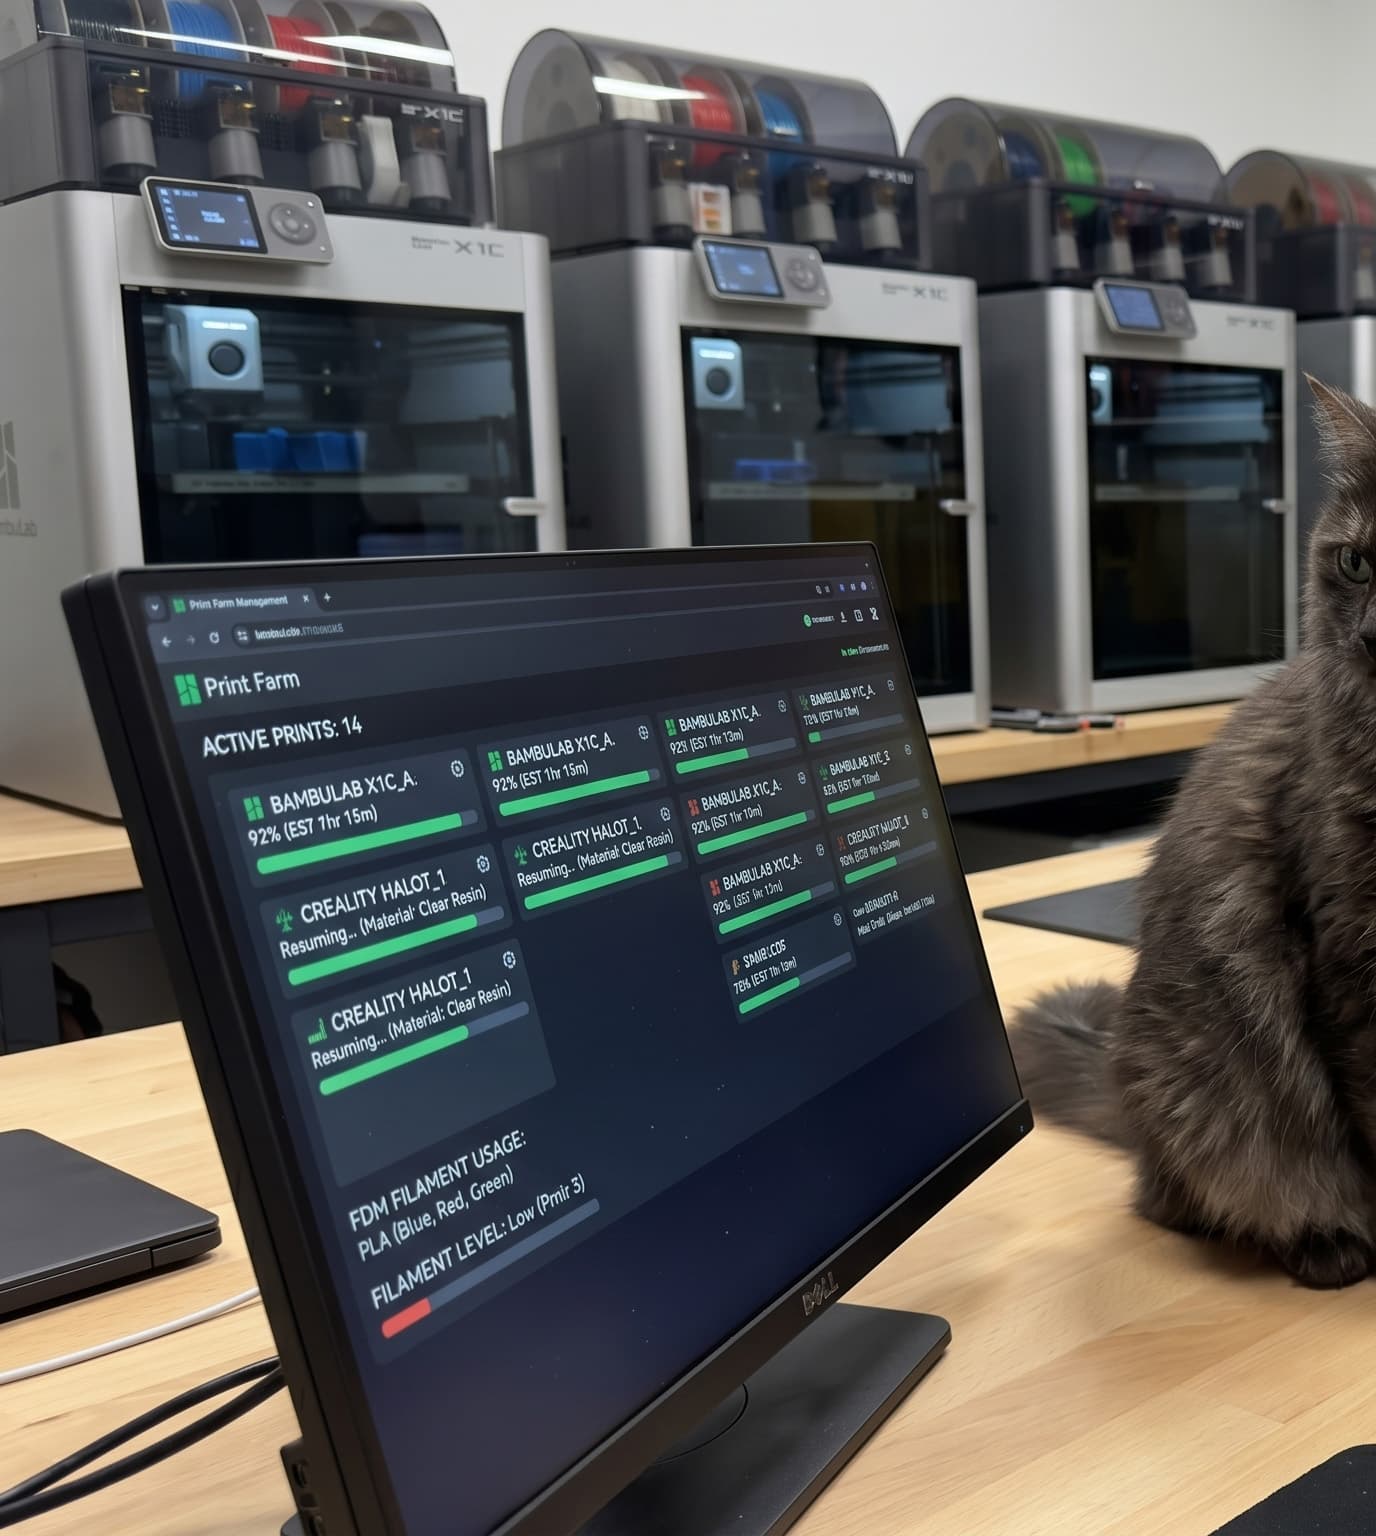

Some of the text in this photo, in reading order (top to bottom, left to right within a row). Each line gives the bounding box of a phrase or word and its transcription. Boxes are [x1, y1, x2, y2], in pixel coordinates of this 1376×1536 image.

[455, 240, 504, 258] X1C
[204, 672, 300, 698] Print Farm
[203, 715, 363, 757] ACTIVE PRINTS: 14
[679, 712, 730, 732] BAMBULAB
[506, 739, 574, 766] BAMBULAB
[492, 760, 589, 793] 92% (EST 1hr 15m)
[270, 780, 363, 814] BAMBULAB
[701, 786, 751, 811] BAMBULAB
[249, 823, 281, 847] 92%
[344, 805, 378, 826] 15m)
[532, 827, 590, 858] CREALITY
[621, 840, 645, 856] Clear
[723, 862, 773, 891] BAMBULAB
[300, 868, 447, 924] CREALITY HALOT_1
[419, 897, 449, 917] Clear
[451, 883, 487, 907] Resin)
[331, 967, 472, 1032] CREALITY HALOT_1
[311, 980, 511, 1070] Resuming... (Material: Clear Resin)
[348, 1129, 527, 1232] FDM FILAMENT USAGE:
[358, 1164, 514, 1262] PLA (Blue, Red, Green)
[371, 1246, 453, 1310] FILAMENT
[455, 1221, 507, 1262] LEVEL:
[507, 1205, 536, 1232] Low
[571, 1173, 585, 1195] 3)
